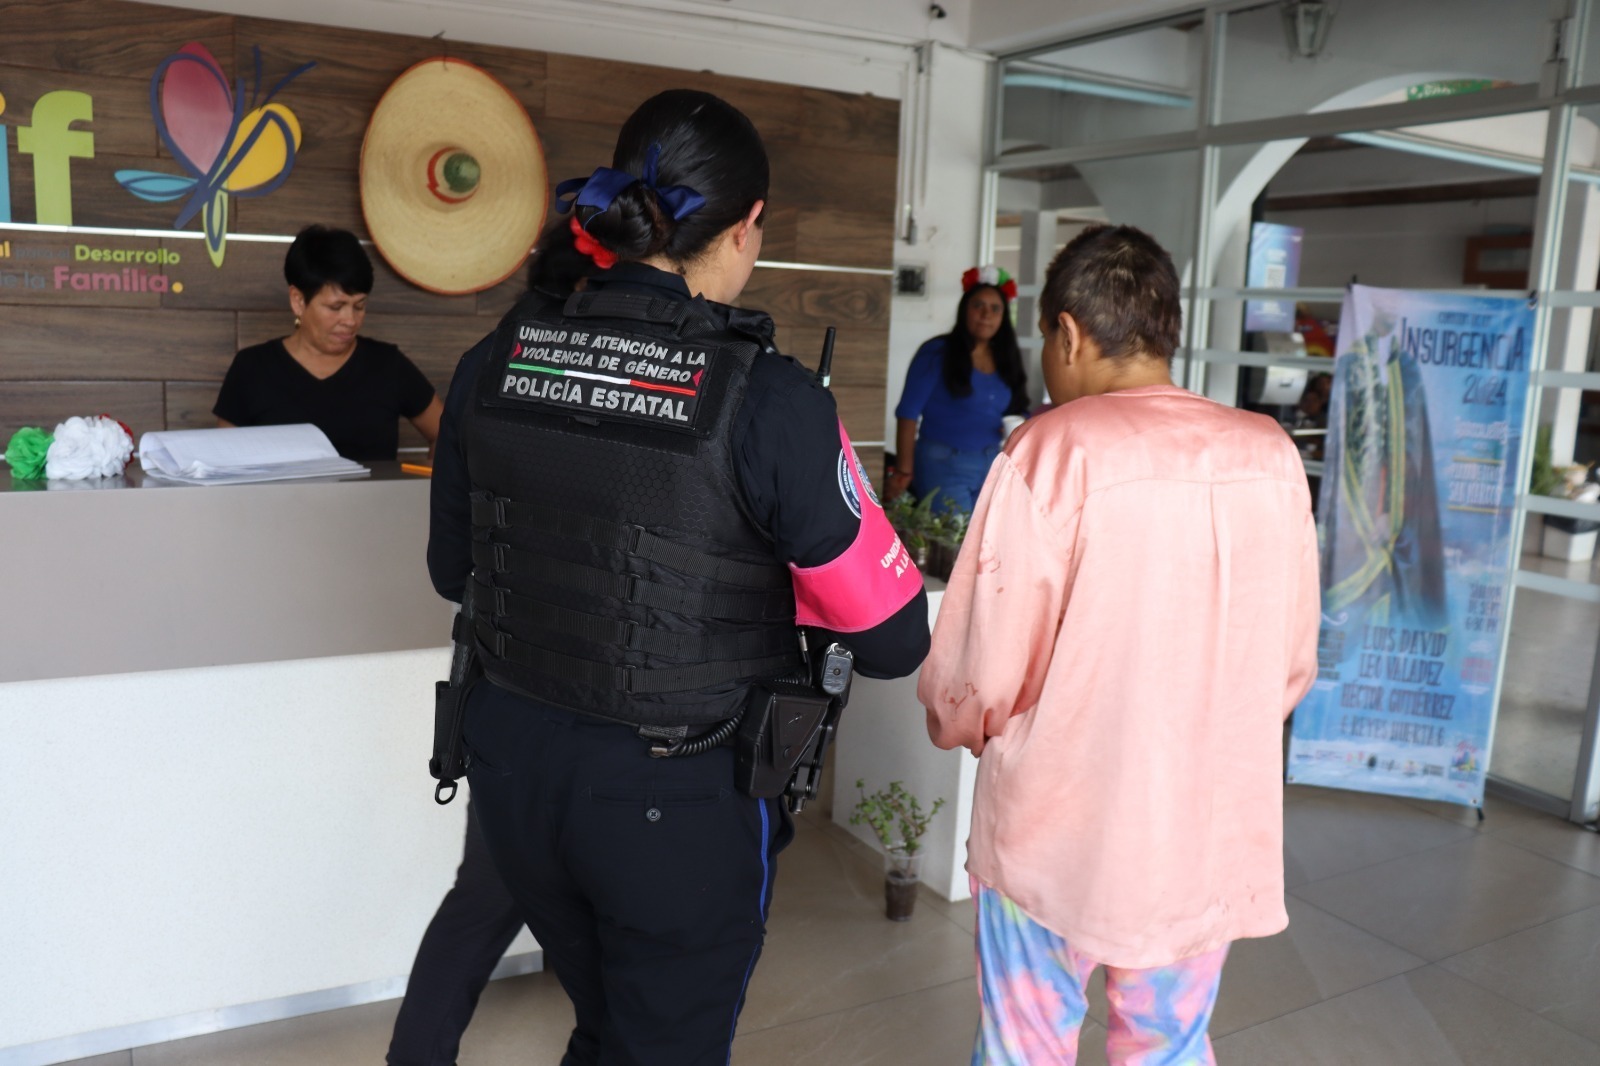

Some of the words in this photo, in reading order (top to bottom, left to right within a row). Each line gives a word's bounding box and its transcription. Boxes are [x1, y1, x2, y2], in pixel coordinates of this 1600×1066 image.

[74, 244, 181, 265] Desarrollo
[24, 271, 45, 289] la
[519, 326, 567, 344] UNIDAD
[570, 332, 590, 346] DE
[591, 335, 669, 360] ATENCIÓN
[671, 351, 683, 364] A
[686, 352, 706, 366] LA
[1400, 316, 1525, 372] INSURGENCIA
[521, 346, 594, 367] VIOLENCIA
[597, 355, 621, 371] DE
[624, 358, 692, 383] GÉNERO
[502, 374, 583, 404] POLICÍA
[589, 387, 690, 422] ESTATAL
[1462, 374, 1508, 406] 2024
[895, 565, 905, 579] A
